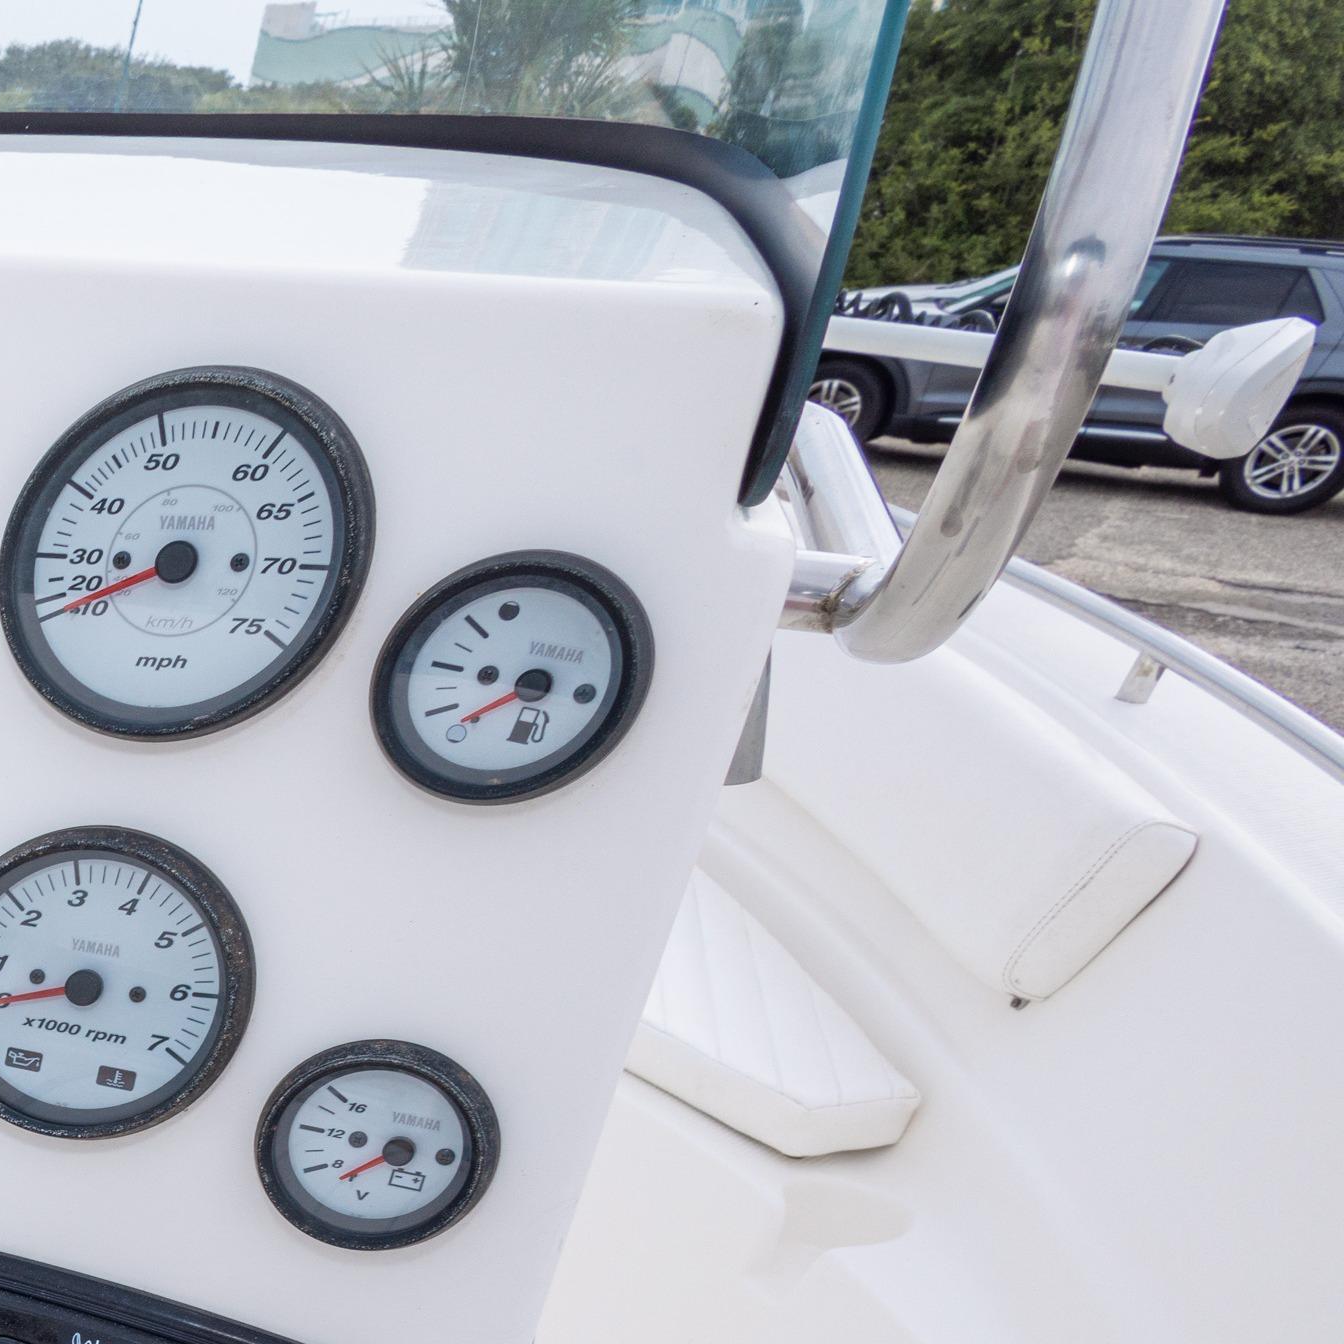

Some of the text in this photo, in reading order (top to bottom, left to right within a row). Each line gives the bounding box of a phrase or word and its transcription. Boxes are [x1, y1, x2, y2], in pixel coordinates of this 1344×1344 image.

[143, 453, 180, 471] 50
[231, 464, 270, 481] 60
[90, 498, 124, 515] 40
[256, 503, 294, 520] 65
[160, 515, 215, 530] YAMAHA
[69, 548, 103, 565] 30
[260, 558, 297, 574] 70
[68, 576, 102, 592] 20
[79, 600, 108, 616] 10
[145, 616, 193, 629] km/h
[228, 618, 265, 635] 75
[530, 641, 584, 664] YAMAHA
[135, 654, 188, 671] mph
[67, 890, 88, 907] 3
[118, 899, 139, 915] 4
[21, 910, 42, 927] 2
[72, 939, 120, 958] YAMAHA
[154, 931, 178, 949] 5
[170, 984, 192, 1001] 6
[23, 1017, 127, 1045] x1000 rpm
[147, 1034, 169, 1051] 7
[348, 1102, 367, 1113] 16
[392, 1112, 441, 1131] YAMAHA
[326, 1128, 346, 1138] 12
[332, 1160, 344, 1168] 8
[356, 1190, 370, 1200] V
